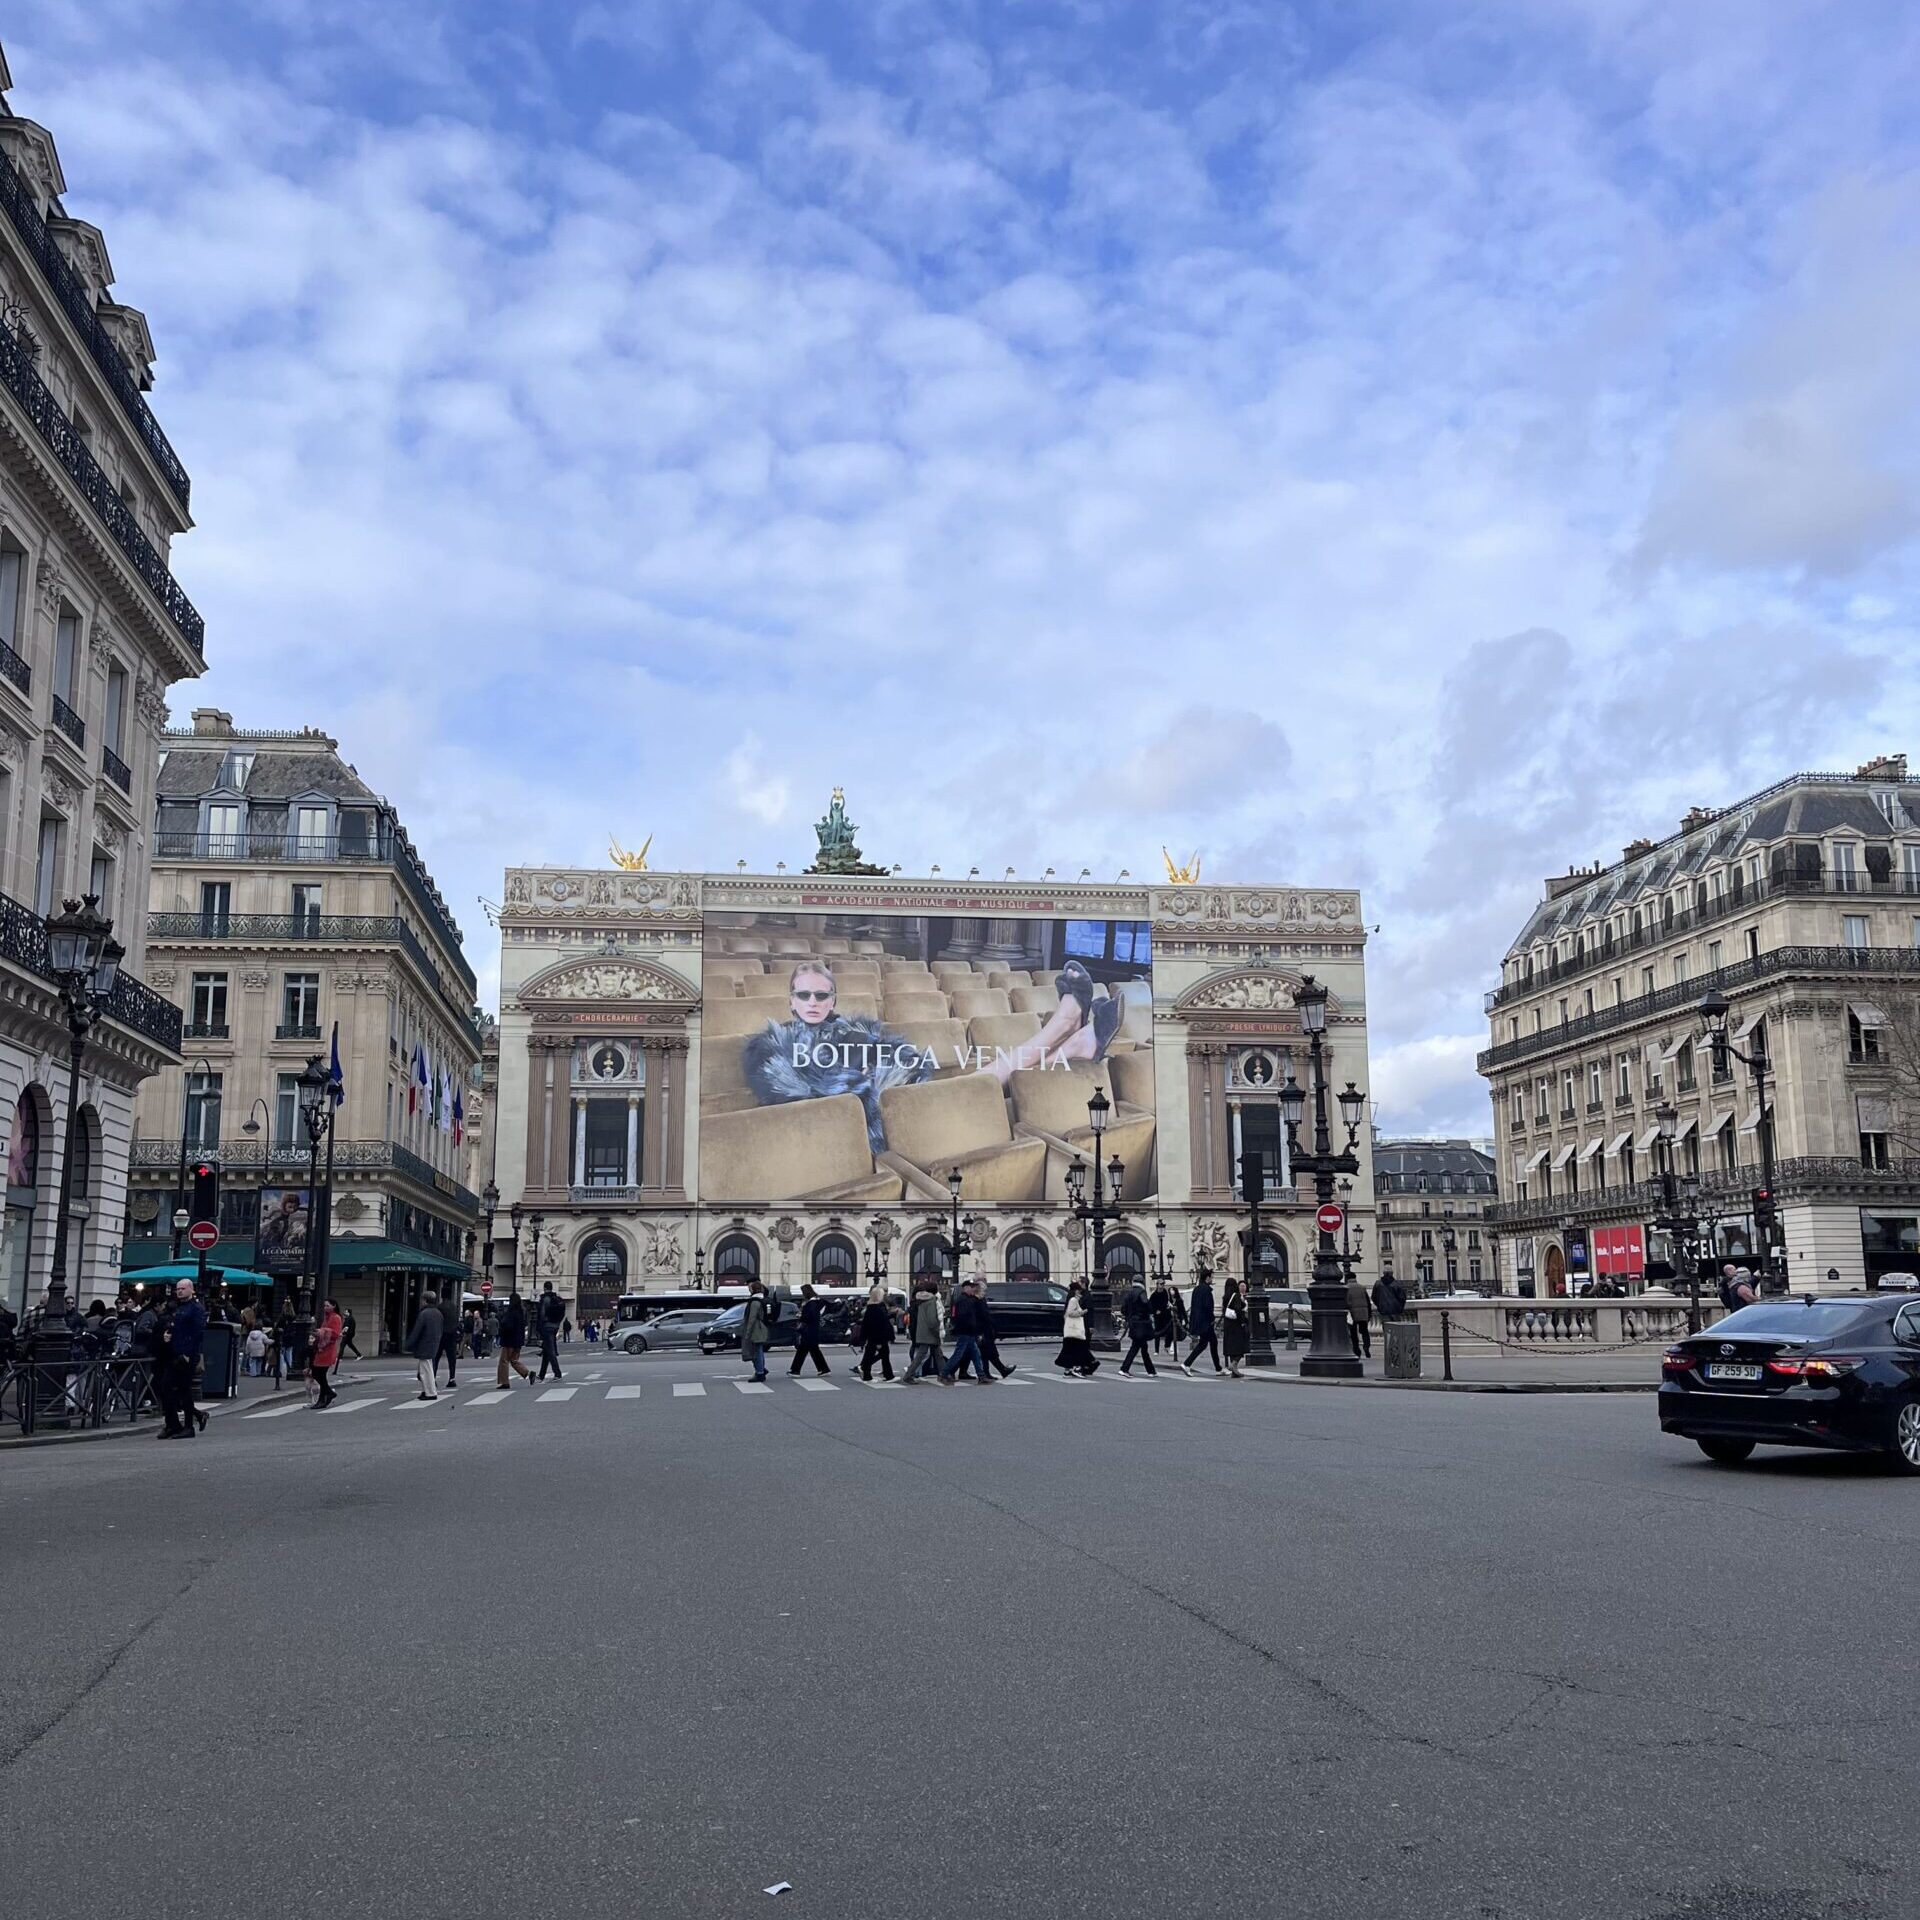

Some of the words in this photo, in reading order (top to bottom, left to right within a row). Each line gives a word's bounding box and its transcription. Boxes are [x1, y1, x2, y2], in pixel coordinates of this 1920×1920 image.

[894, 898, 948, 907] NATIONALE
[957, 899, 973, 908] DE
[980, 900, 1030, 909] MUSIQUE
[792, 1042, 941, 1069] BOTTEGA
[954, 1045, 1071, 1072] VENETA
